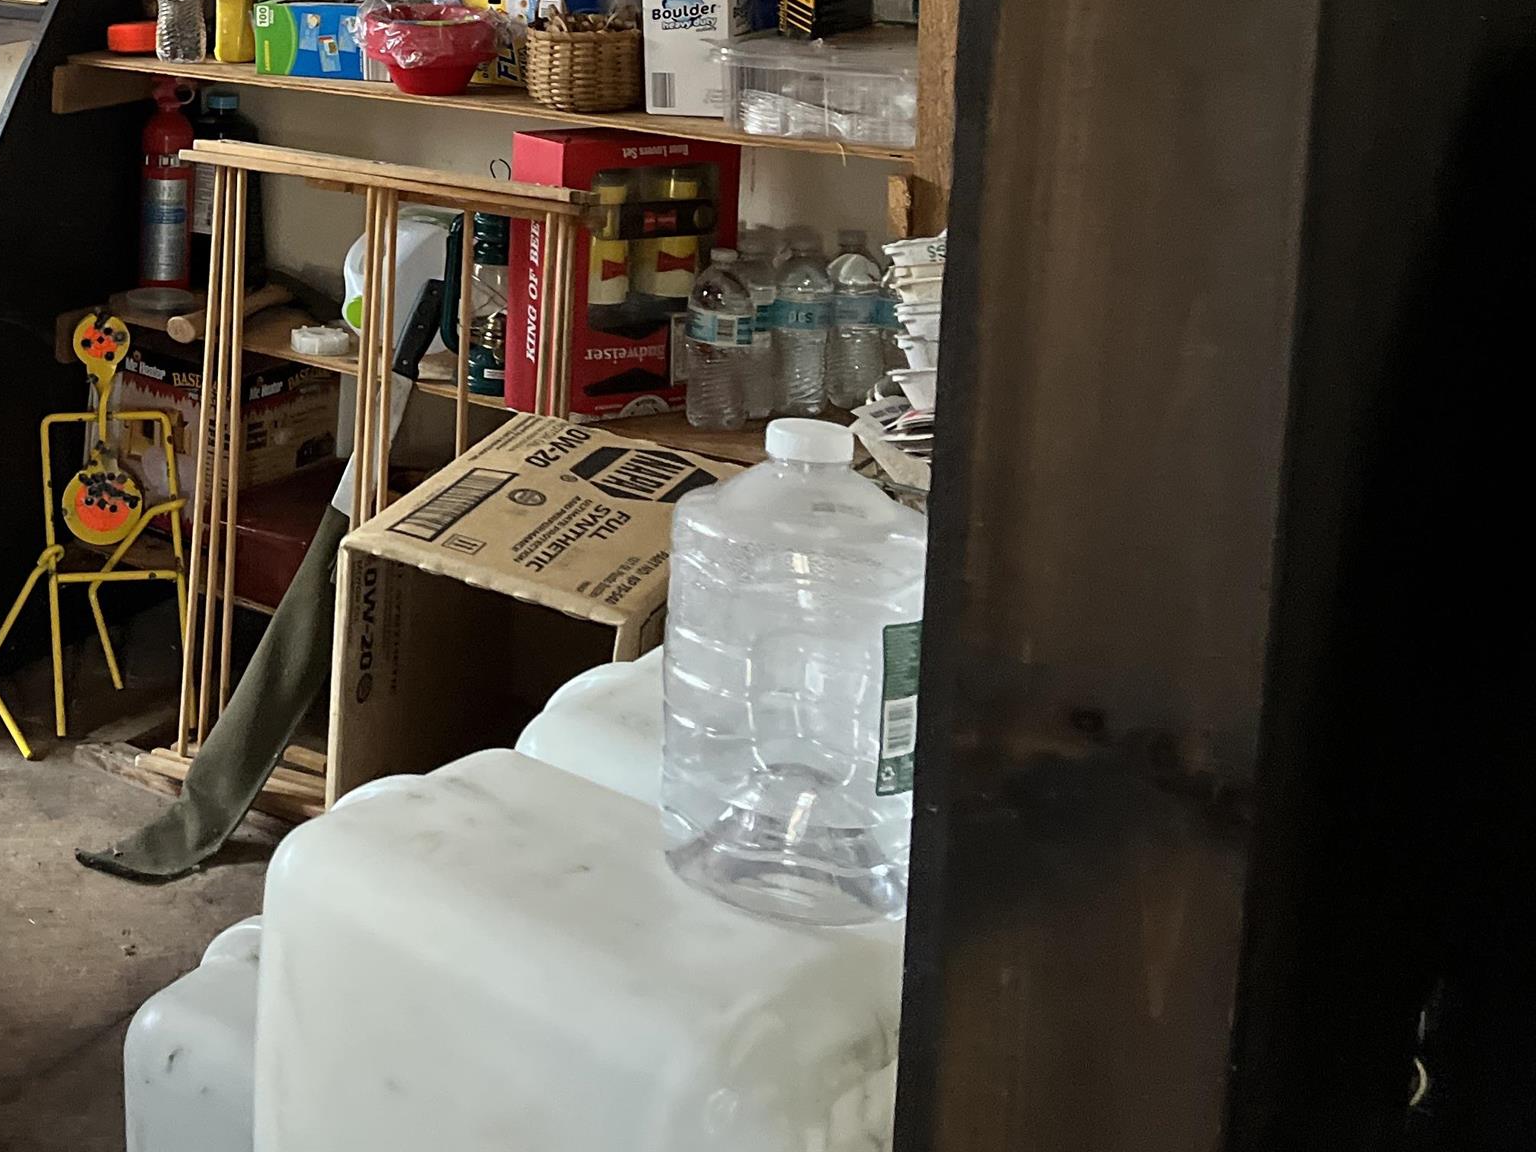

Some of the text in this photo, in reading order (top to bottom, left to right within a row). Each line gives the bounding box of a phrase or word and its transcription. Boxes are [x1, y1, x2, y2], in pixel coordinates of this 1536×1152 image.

[257, 6, 268, 25] 100
[651, 2, 717, 22] Boulder
[661, 19, 692, 31] heavy
[692, 16, 718, 30] duty
[621, 147, 638, 160] Set
[525, 218, 541, 364] KING OF BEE
[583, 344, 665, 364] Budweiser
[171, 371, 202, 389] BASE
[525, 428, 591, 469] 0W-20
[600, 452, 686, 496] NAPA
[588, 509, 632, 541] FULL
[524, 503, 612, 574] SYNTHETIC
